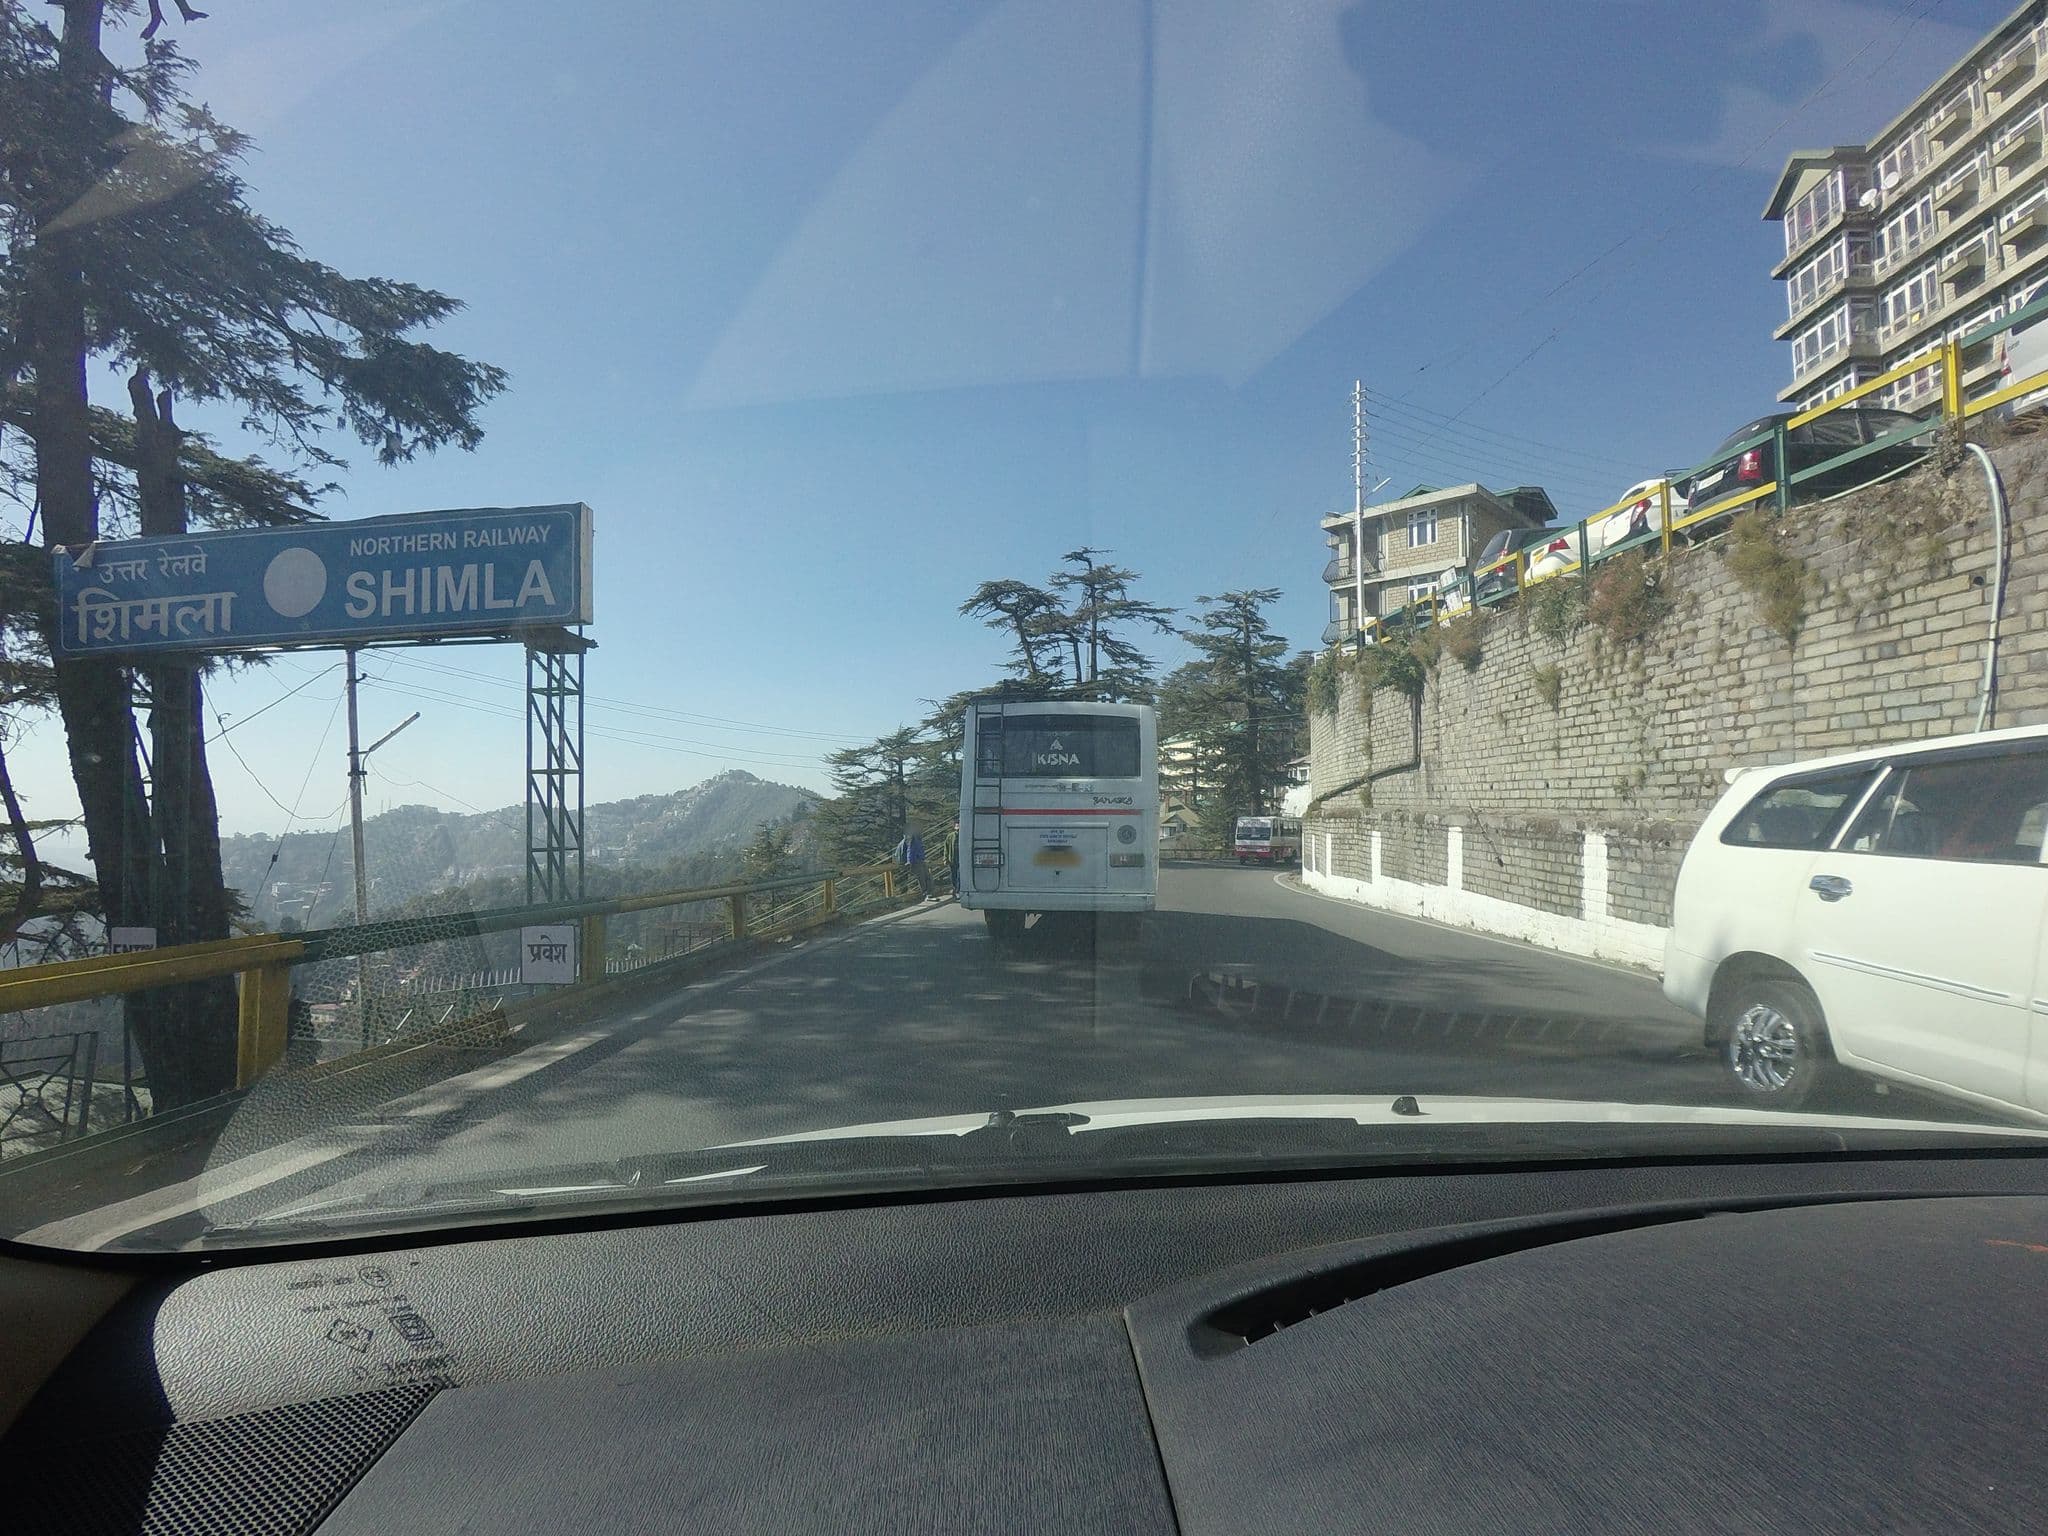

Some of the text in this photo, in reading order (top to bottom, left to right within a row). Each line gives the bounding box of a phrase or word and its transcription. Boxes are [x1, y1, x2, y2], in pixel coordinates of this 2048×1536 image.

[350, 525, 551, 557] NORTHERN RAILWAY
[97, 545, 209, 584] उत्तर रेलवे
[344, 559, 557, 619] SHIMLA
[70, 586, 238, 645] शिमला
[1037, 752, 1081, 766] KISNA
[527, 934, 568, 964] प्रवेश
